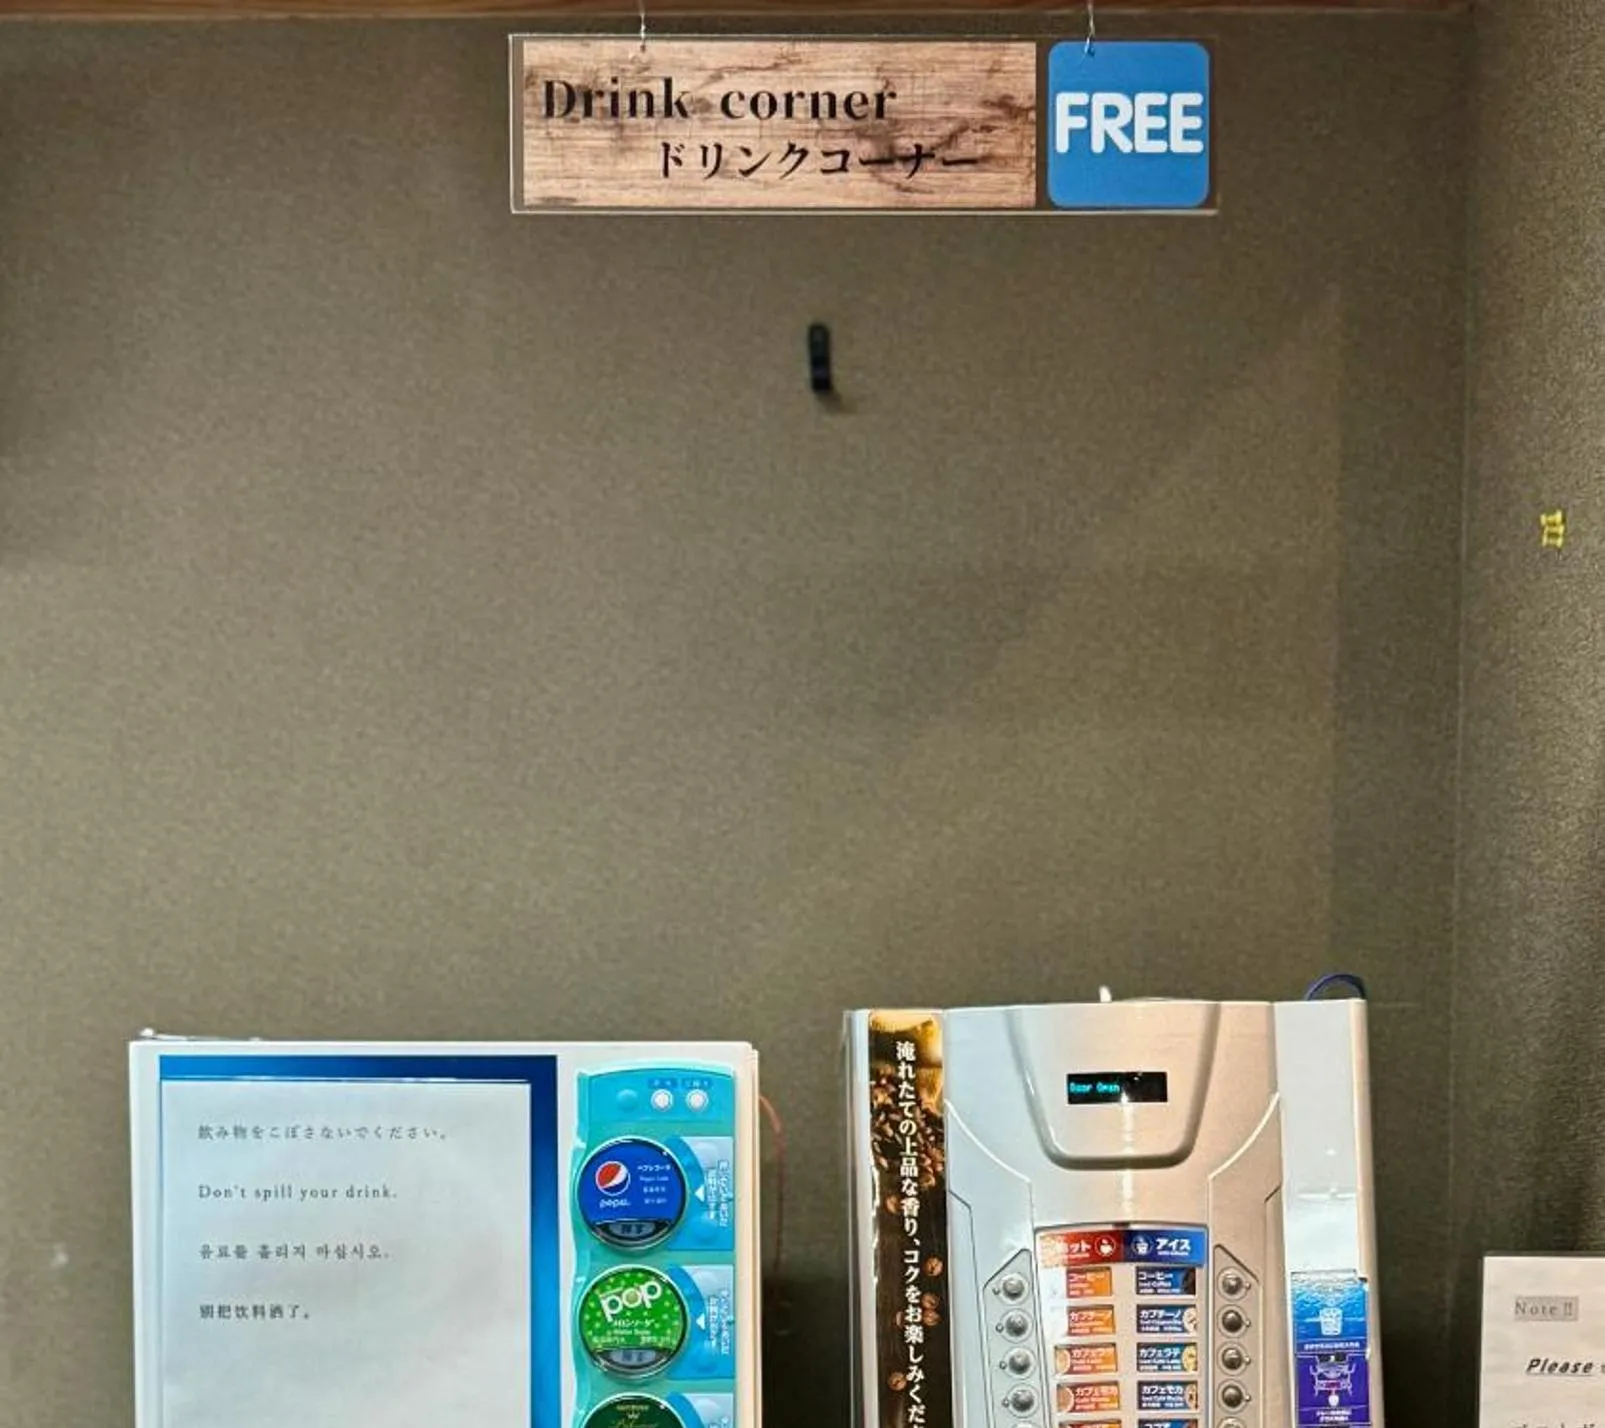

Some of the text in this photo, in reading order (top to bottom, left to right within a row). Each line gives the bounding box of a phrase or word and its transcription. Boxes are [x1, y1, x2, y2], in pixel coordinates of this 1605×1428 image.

[543, 75, 898, 121] Drink corner
[1054, 90, 1204, 154] FREE
[659, 141, 981, 179] ドリンクコーナー
[198, 1184, 247, 1199] Don't
[254, 1184, 293, 1202] spill
[300, 1187, 338, 1202] your
[1155, 1237, 1192, 1251] アイス
[600, 1280, 663, 1323] pop
[1526, 1358, 1593, 1375] Please
